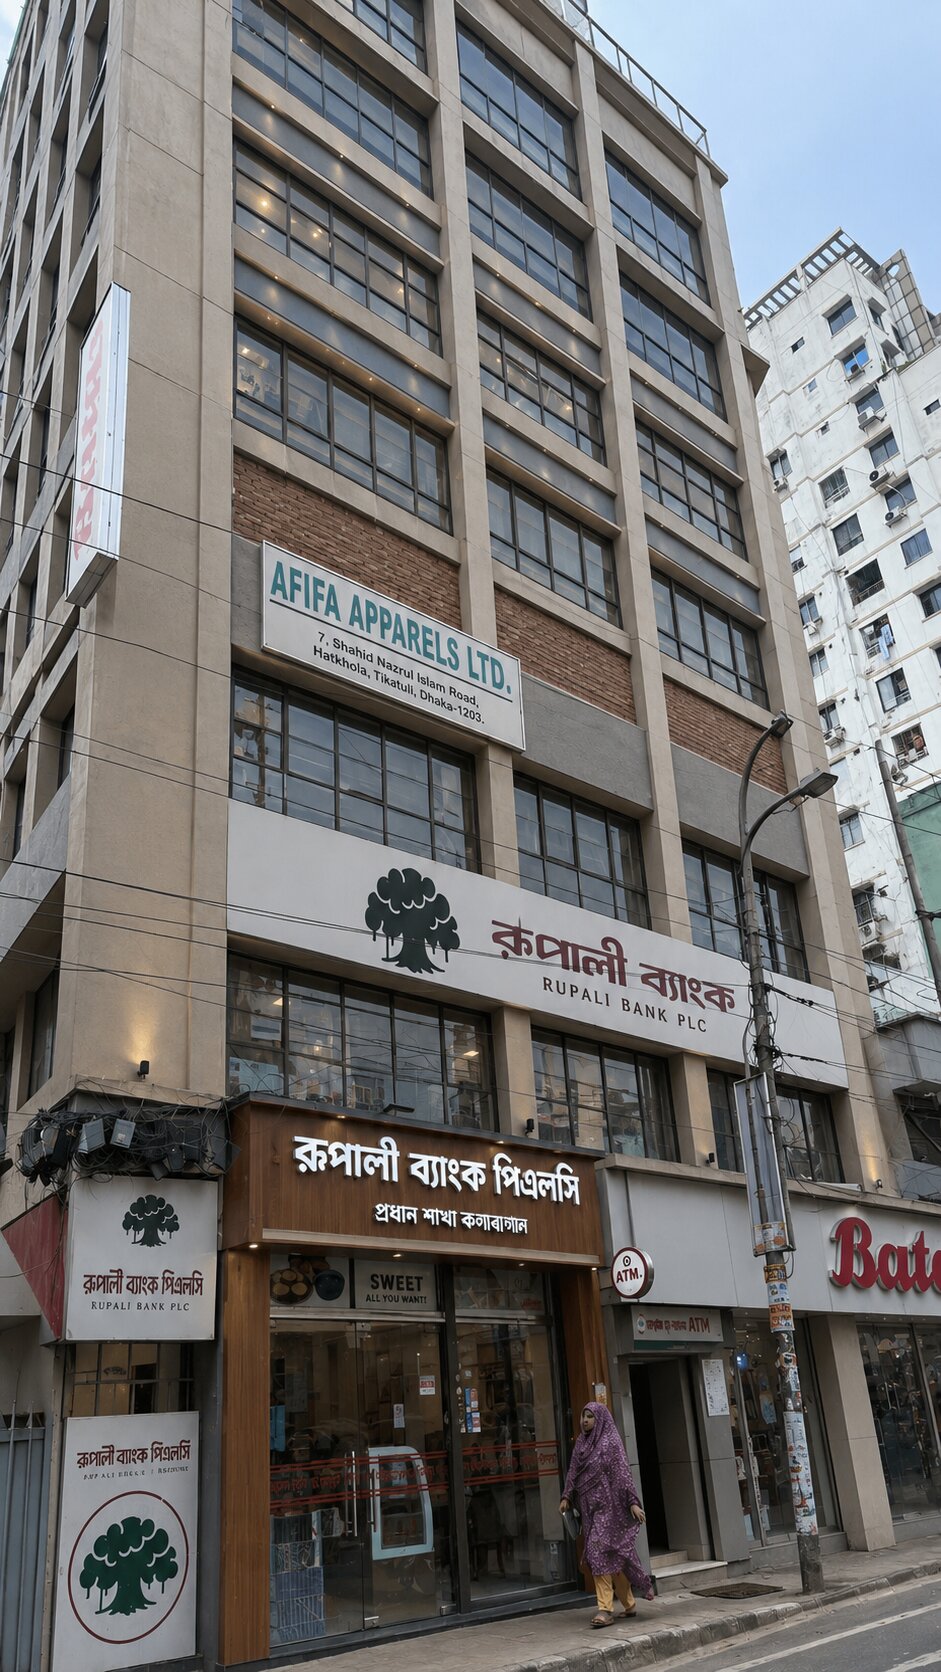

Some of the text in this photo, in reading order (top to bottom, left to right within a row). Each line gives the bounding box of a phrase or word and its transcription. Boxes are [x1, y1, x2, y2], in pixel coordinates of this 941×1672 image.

[270, 561, 512, 694] AFIFA APPARELS LTD.
[333, 638, 373, 663] Shahid
[377, 656, 414, 681] Nazrul
[417, 673, 446, 694] Islam
[313, 645, 484, 724] Hatkhola, Tikatuli, Dhaka-1203.
[639, 963, 735, 1012] ব্যাংক
[543, 977, 707, 1033] RUPALI BANK PLC
[407, 1152, 487, 1192] ব্যাংক
[492, 1152, 580, 1205] পিএলসি
[375, 1203, 418, 1224] প্রধান
[422, 1208, 457, 1228] শাখা
[126, 1275, 159, 1296] ব্যাংক
[161, 1269, 204, 1296] পিএলসি
[370, 1273, 423, 1292] SWEET
[91, 1301, 190, 1311] RUPALI BANK PLC
[365, 1293, 381, 1303] ALL
[382, 1294, 399, 1303] YOU
[688, 1317, 711, 1333] ATM
[116, 1448, 148, 1465] ব্যাংক
